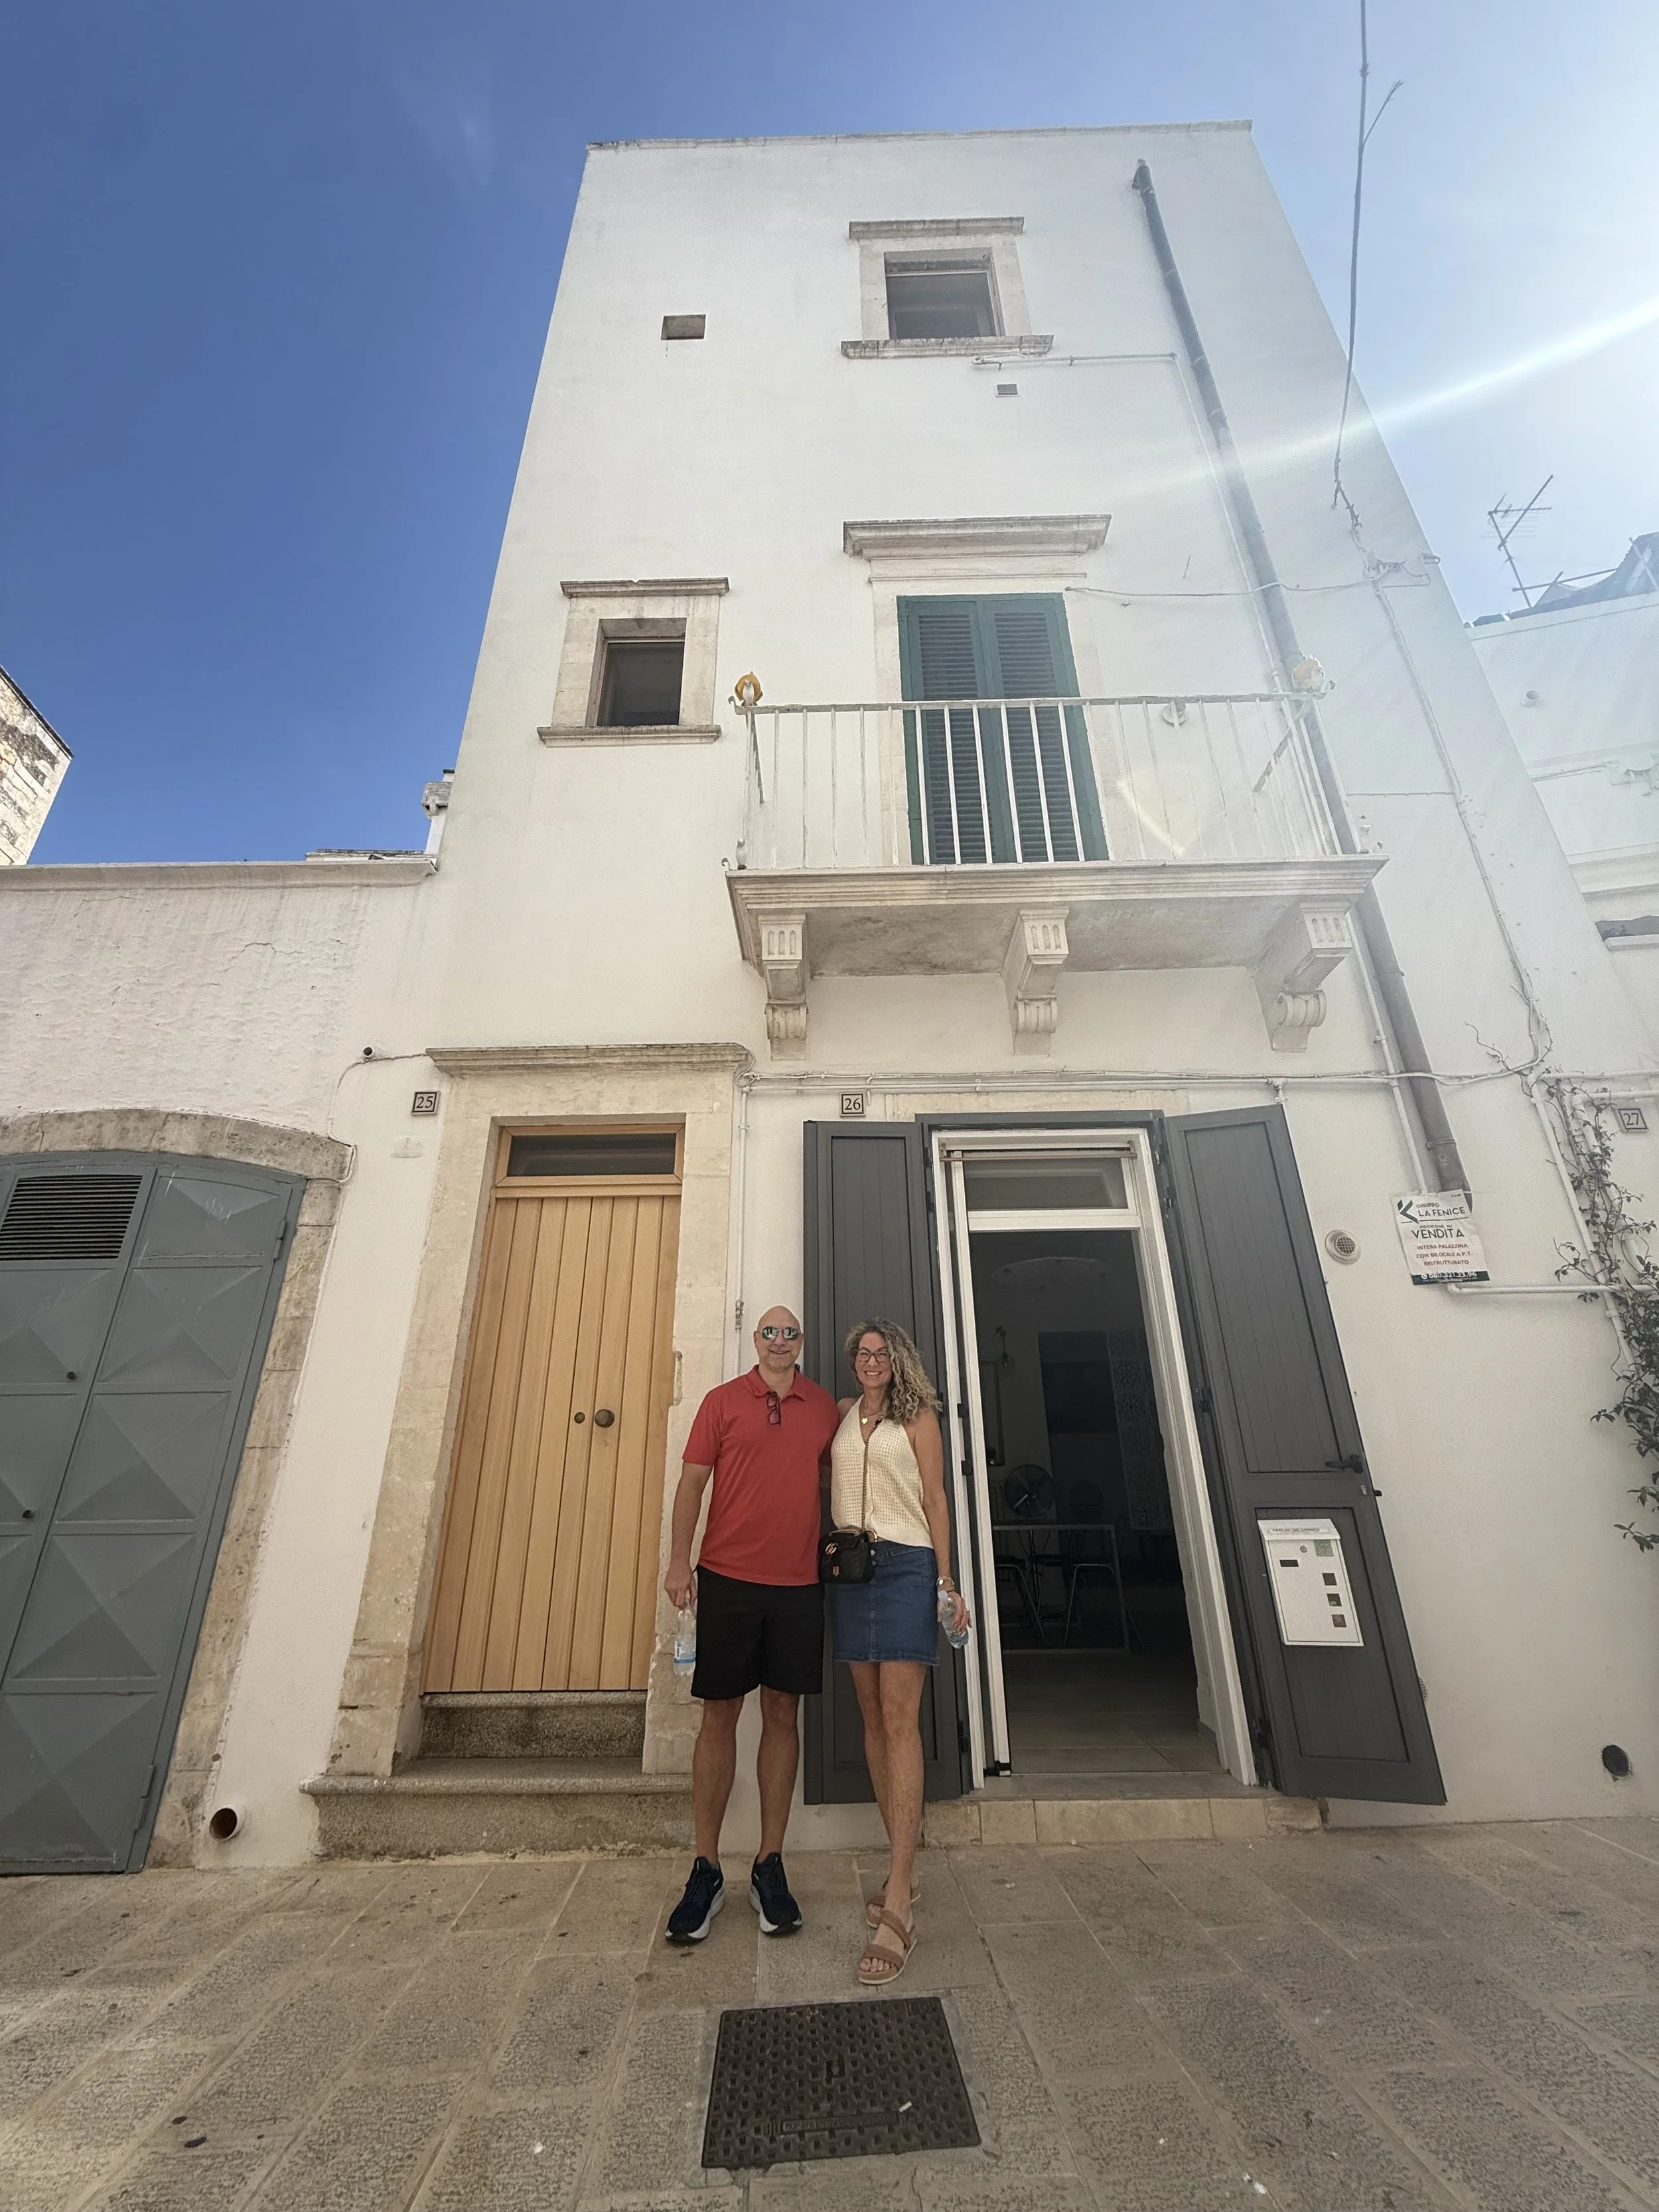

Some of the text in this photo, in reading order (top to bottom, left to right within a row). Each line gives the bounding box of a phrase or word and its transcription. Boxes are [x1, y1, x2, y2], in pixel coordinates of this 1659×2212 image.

[416, 1096, 433, 1108] 25
[844, 1097, 861, 1110] 26
[1623, 1112, 1638, 1126] 27
[1433, 1207, 1465, 1217] FENICE
[1411, 1228, 1465, 1239] VENDITA
